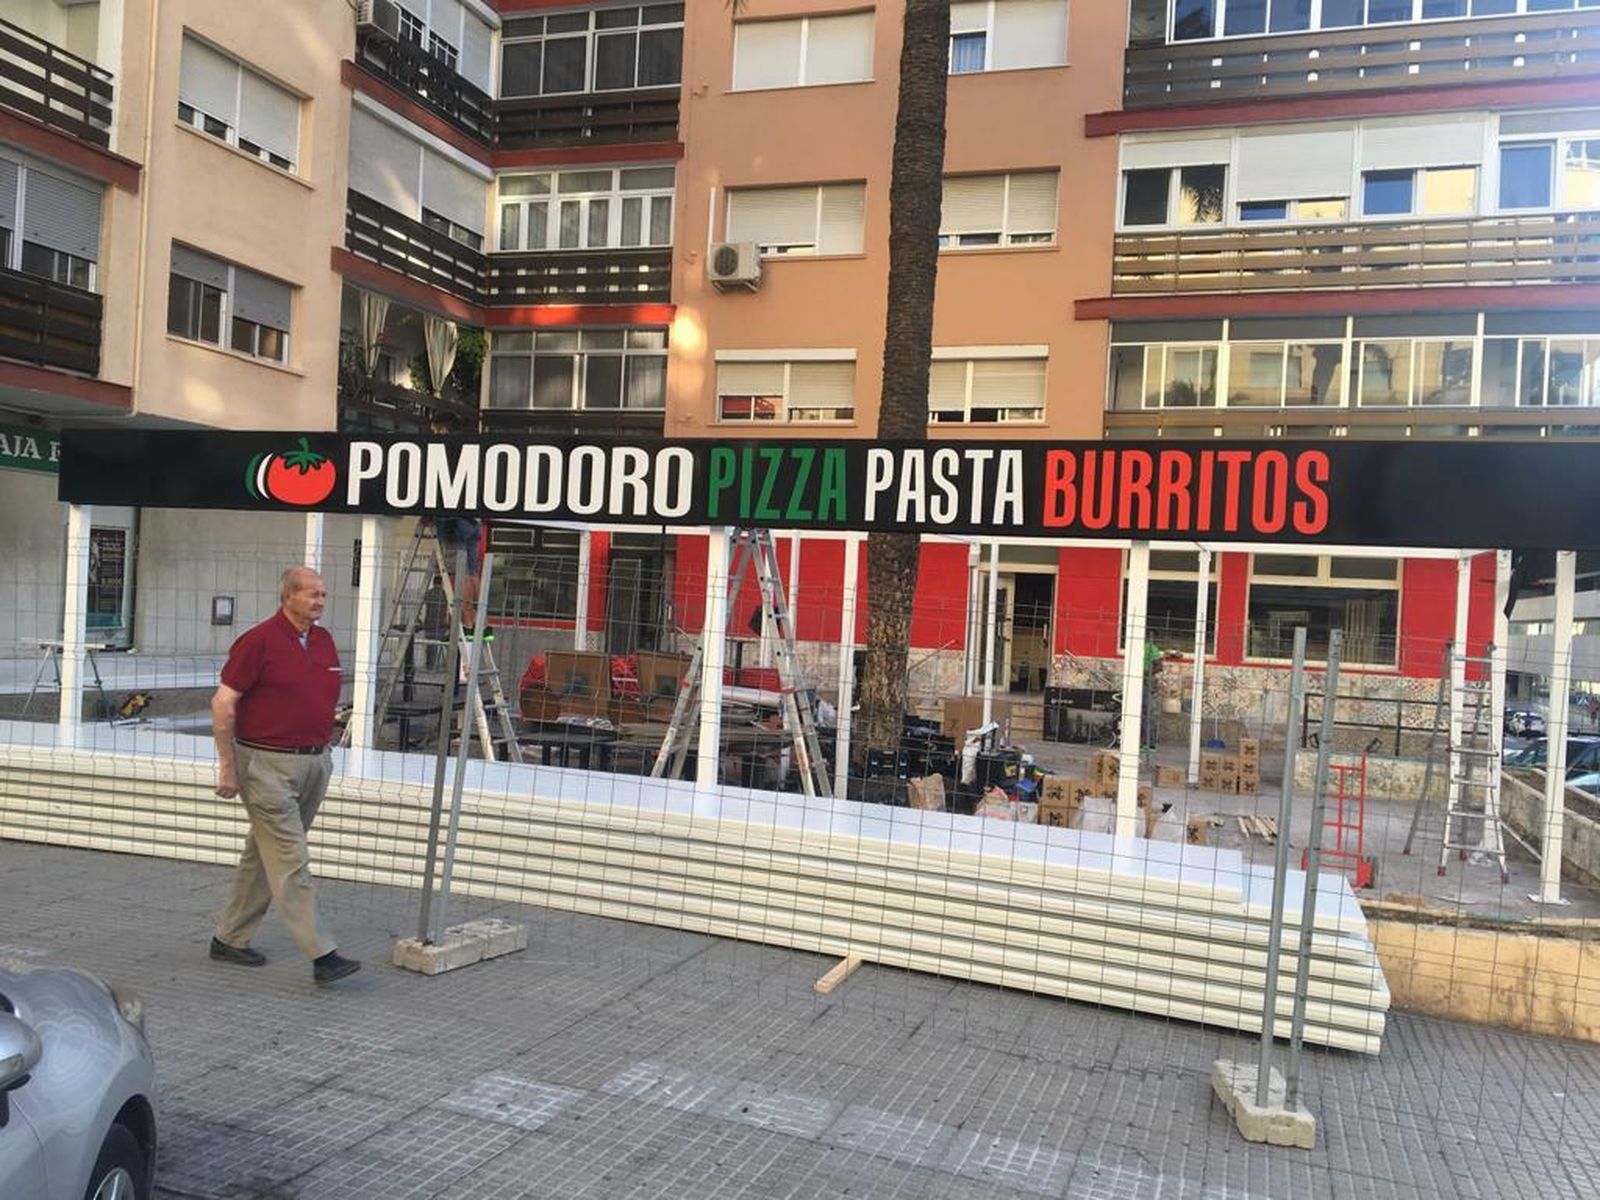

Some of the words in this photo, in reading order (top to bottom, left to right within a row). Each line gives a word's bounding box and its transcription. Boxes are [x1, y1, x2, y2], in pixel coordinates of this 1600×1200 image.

[346, 441, 694, 518] POMODORO
[708, 447, 848, 521] PIZZA
[864, 448, 1024, 526] PASTA
[1042, 449, 1330, 535] BURRITOS
